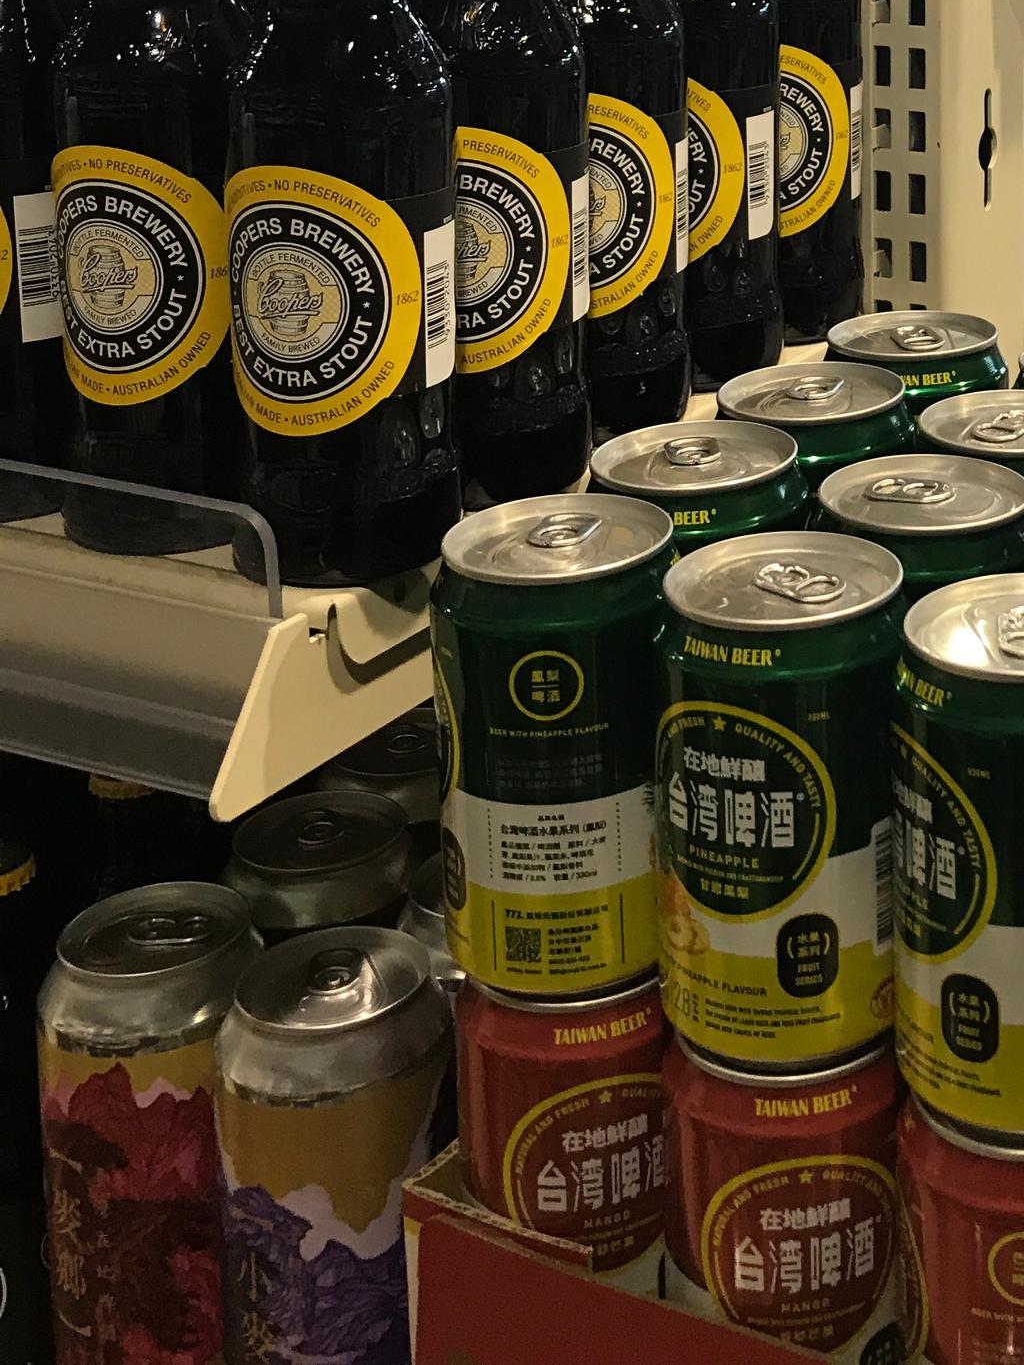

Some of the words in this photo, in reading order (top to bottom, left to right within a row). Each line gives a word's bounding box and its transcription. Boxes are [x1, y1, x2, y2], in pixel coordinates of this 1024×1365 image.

[589, 104, 650, 140] RESERVATIVES
[780, 84, 824, 133] REWERY
[463, 138, 540, 178] PRESERVATIVES
[589, 138, 645, 196] REWERY
[788, 147, 824, 196] STOUT
[89, 159, 103, 169] NO
[106, 160, 192, 204] PRESERVATIVES
[274, 179, 290, 191] NO
[294, 180, 381, 229] PRESERVATIVES
[459, 173, 535, 240] BREWERY
[95, 228, 144, 258] FERMENTED
[104, 196, 189, 268] BREWERY
[602, 213, 645, 269] STOUT
[231, 217, 282, 283] COOPERS
[290, 219, 375, 294] BREWERY
[278, 253, 331, 284] FERMENTED
[636, 250, 659, 284] OWNED
[395, 289, 420, 306] 1862
[490, 259, 534, 319] STOUT
[78, 331, 136, 359] EXTRA
[140, 288, 188, 350] STOUT
[288, 335, 321, 354] BREWED
[461, 332, 525, 365] AUSTRALIAN
[525, 298, 551, 334] OWNED
[113, 366, 179, 396] AUSTRALIAN
[178, 331, 212, 369] OWNED
[253, 358, 317, 388] EXTRA
[319, 315, 373, 380] STOUT
[291, 397, 362, 426] AUSTRALIAN
[362, 360, 395, 399] OWNED
[922, 371, 951, 386] BEER
[674, 509, 711, 526] BEER
[683, 635, 728, 665] TAIWAN
[731, 646, 773, 667] BEER
[914, 678, 944, 707] BEER
[735, 723, 785, 754] QUALITY
[784, 751, 806, 774] AND
[803, 773, 821, 808] TASTY
[689, 844, 759, 870] PINEAPPLE
[722, 981, 767, 997] FLAVOUR
[554, 1023, 607, 1045] TAIWAN
[610, 1011, 646, 1037] BEER
[755, 1097, 809, 1119] TAIWAN
[813, 1089, 852, 1114] BEER
